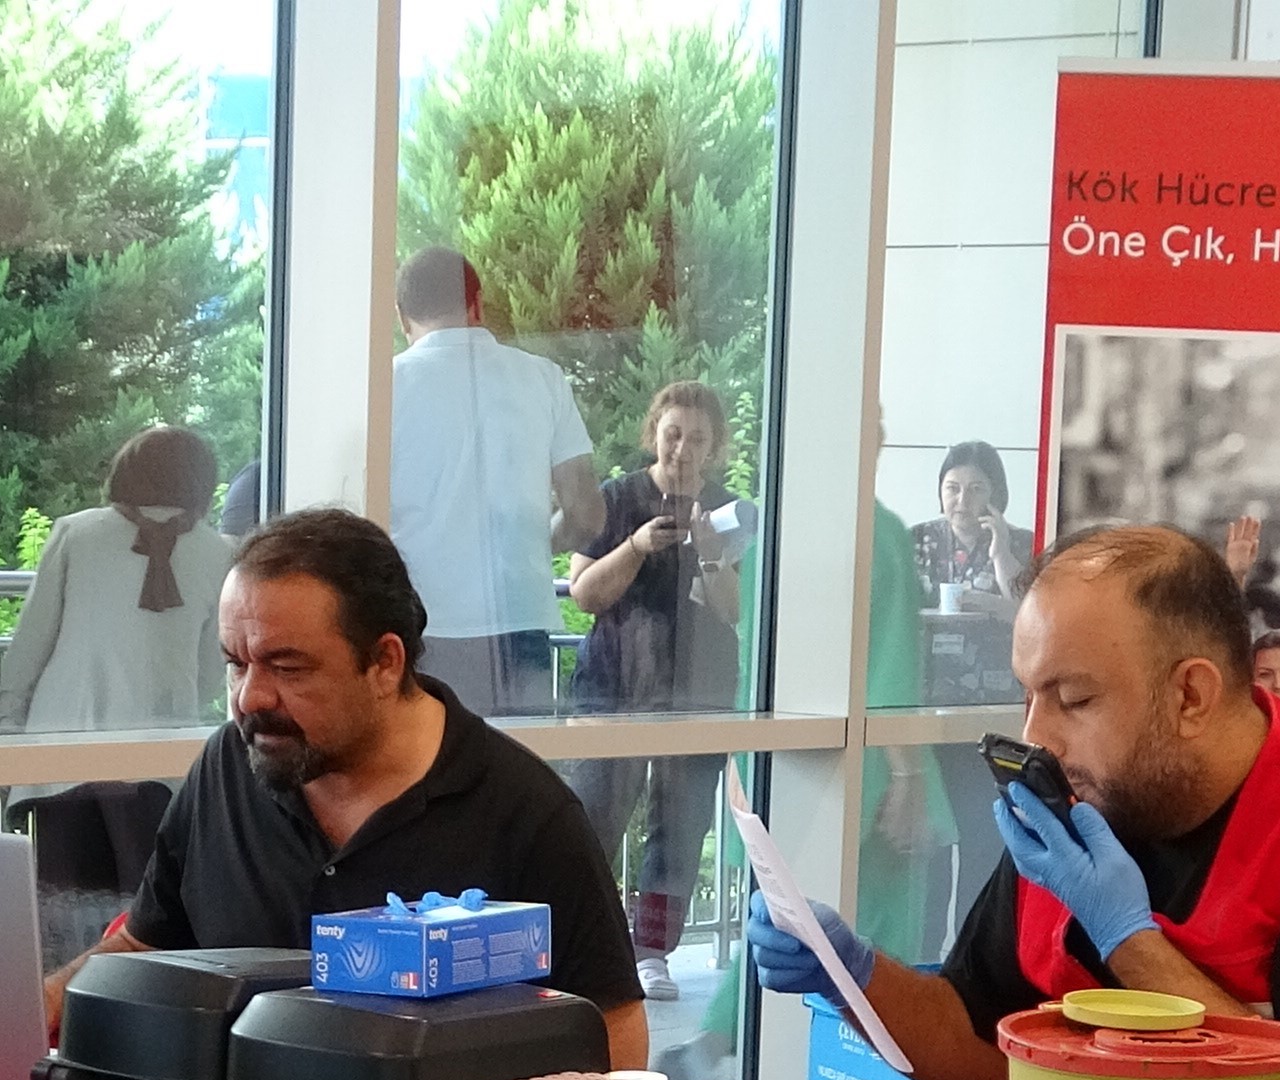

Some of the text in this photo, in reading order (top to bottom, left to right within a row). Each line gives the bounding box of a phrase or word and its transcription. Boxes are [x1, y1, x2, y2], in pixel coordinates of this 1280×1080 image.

[1067, 170, 1139, 204] Kök
[1156, 172, 1277, 207] Hücre
[1062, 215, 1146, 257] Öne
[1161, 225, 1235, 267] Çık,
[316, 924, 346, 940] tenty
[316, 952, 329, 983] 403
[428, 957, 438, 989] 403
